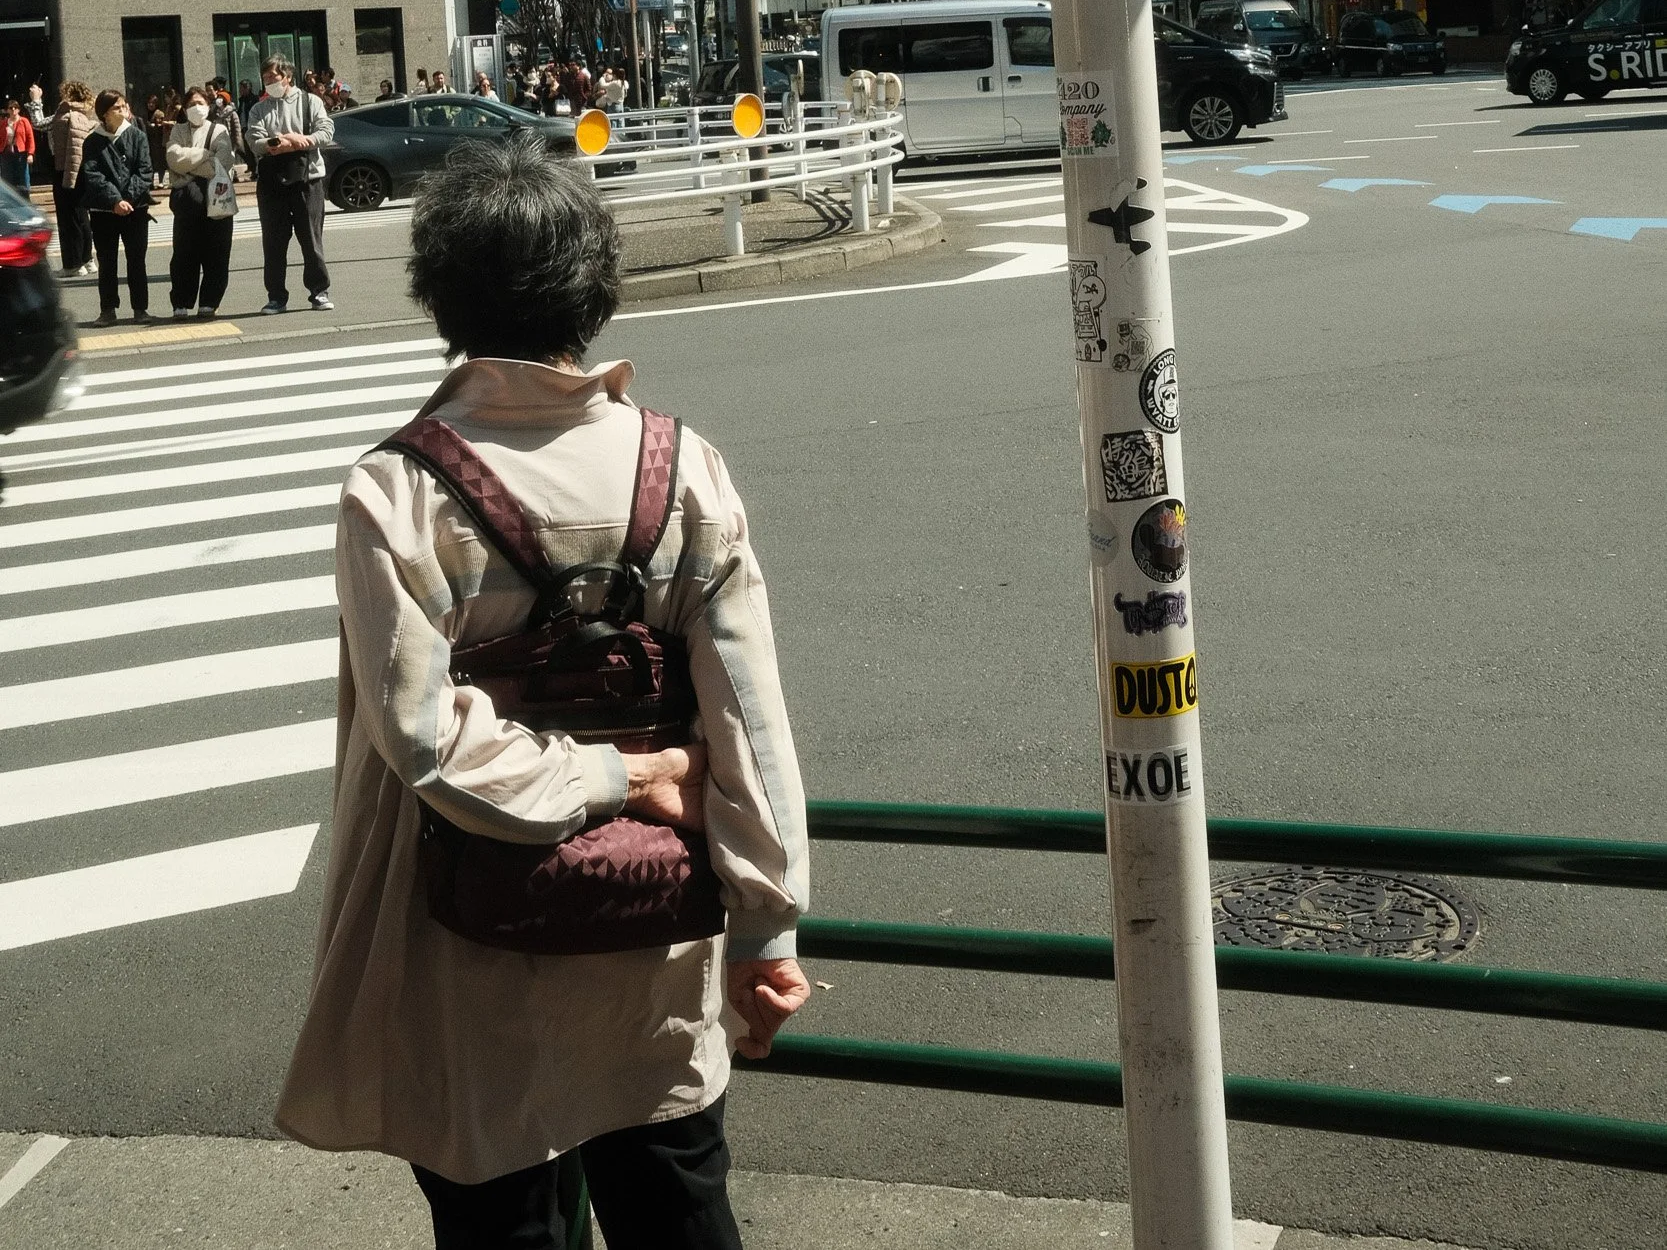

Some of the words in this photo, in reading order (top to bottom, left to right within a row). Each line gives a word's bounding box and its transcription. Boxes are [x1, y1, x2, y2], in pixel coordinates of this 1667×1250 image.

[1587, 39, 1651, 54] タクシーアプリ
[1059, 101, 1107, 119] ompany
[1146, 397, 1173, 428] WYATT
